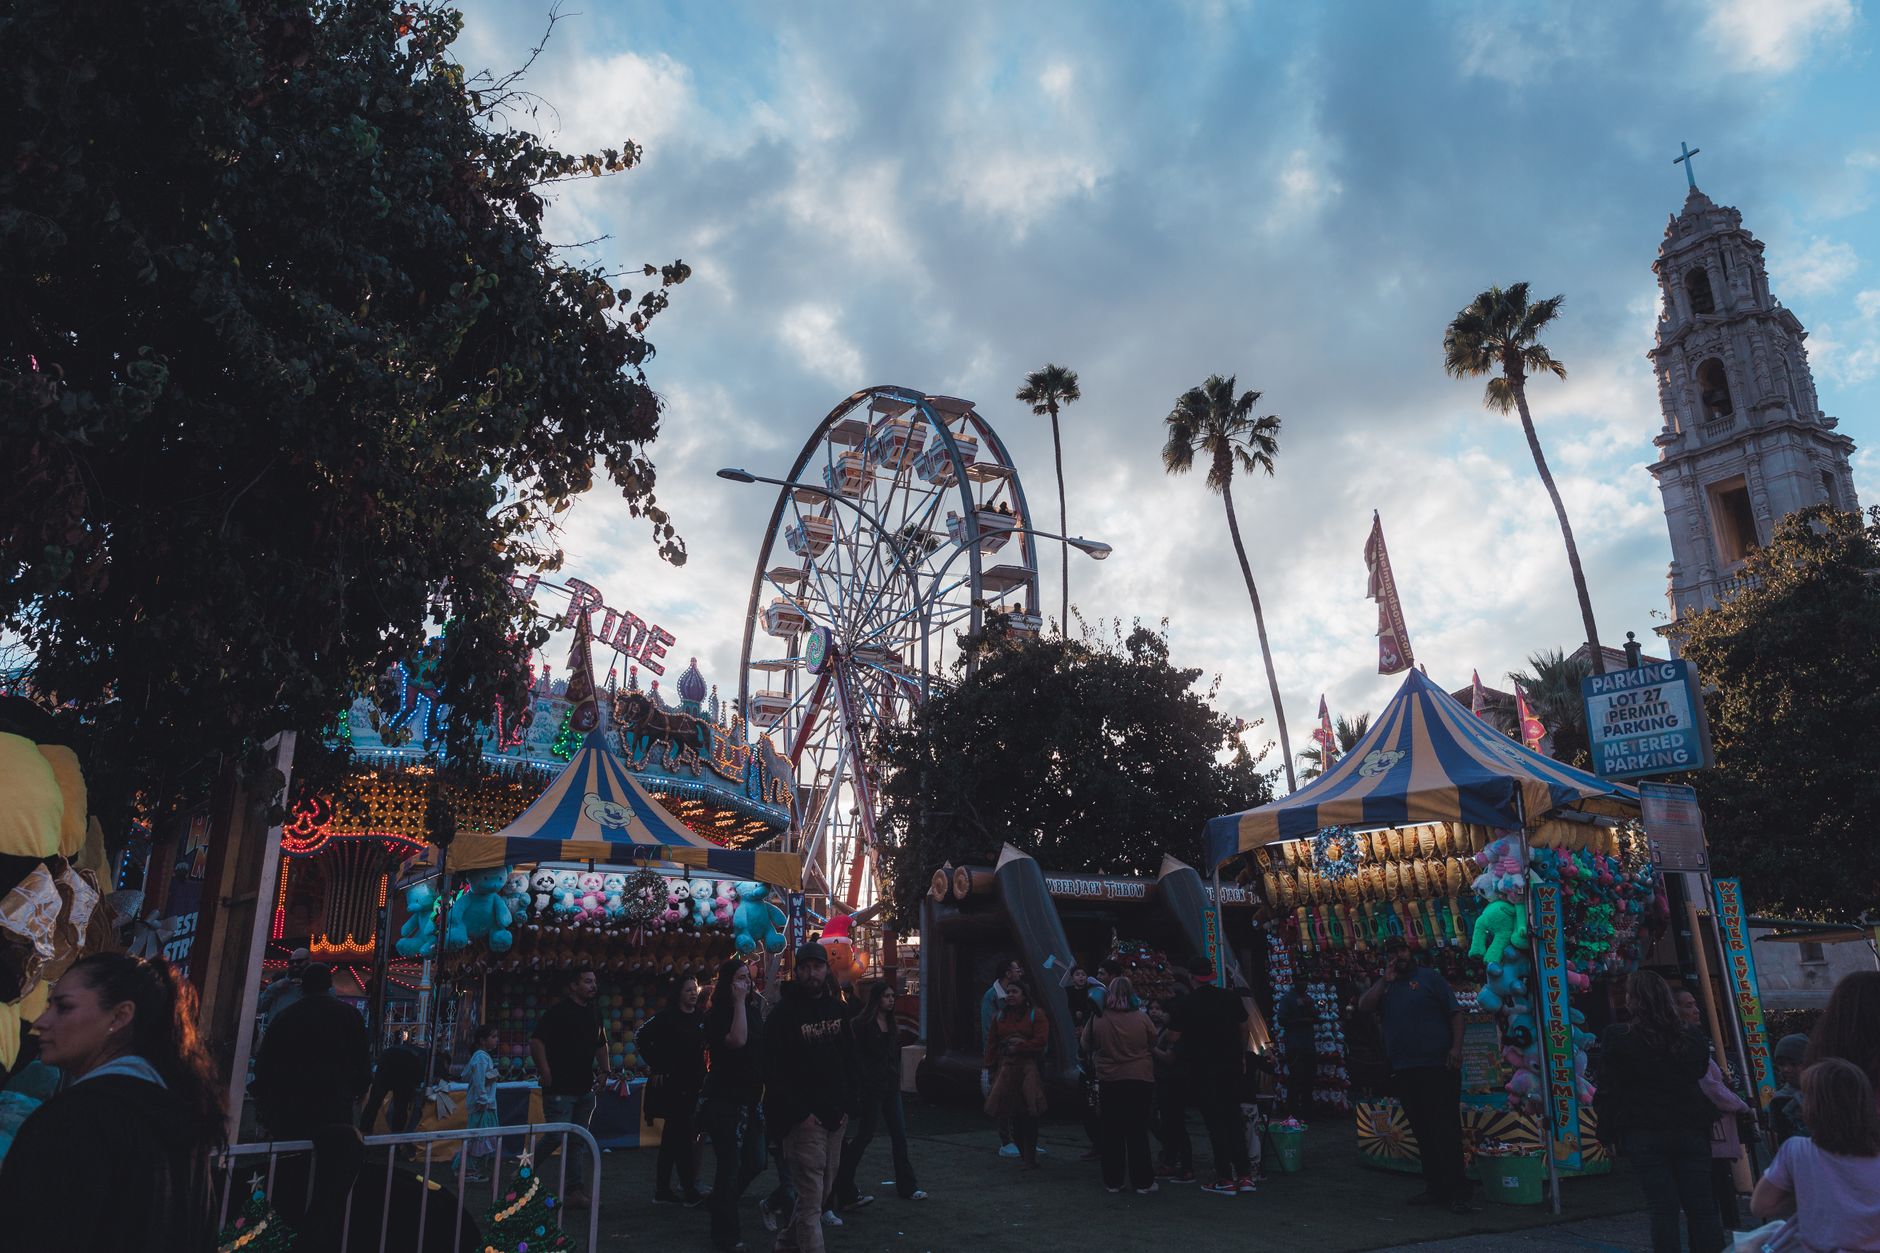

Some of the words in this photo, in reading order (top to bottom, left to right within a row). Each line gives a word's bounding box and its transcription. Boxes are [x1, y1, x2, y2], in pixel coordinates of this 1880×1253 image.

[564, 577, 676, 676] RIDE
[1592, 663, 1676, 693] PARKING
[1608, 692, 1638, 709] LOT
[1643, 687, 1662, 702] 27
[1608, 701, 1668, 722] PERMIT
[1603, 715, 1678, 738] PARKING
[1604, 733, 1684, 758] METERED
[1605, 748, 1688, 773] PARKING
[1536, 886, 1561, 970] WINNER
[1717, 881, 1745, 951] WINNER
[1733, 955, 1758, 1017] EVERY
[1547, 975, 1566, 1049] EVERY
